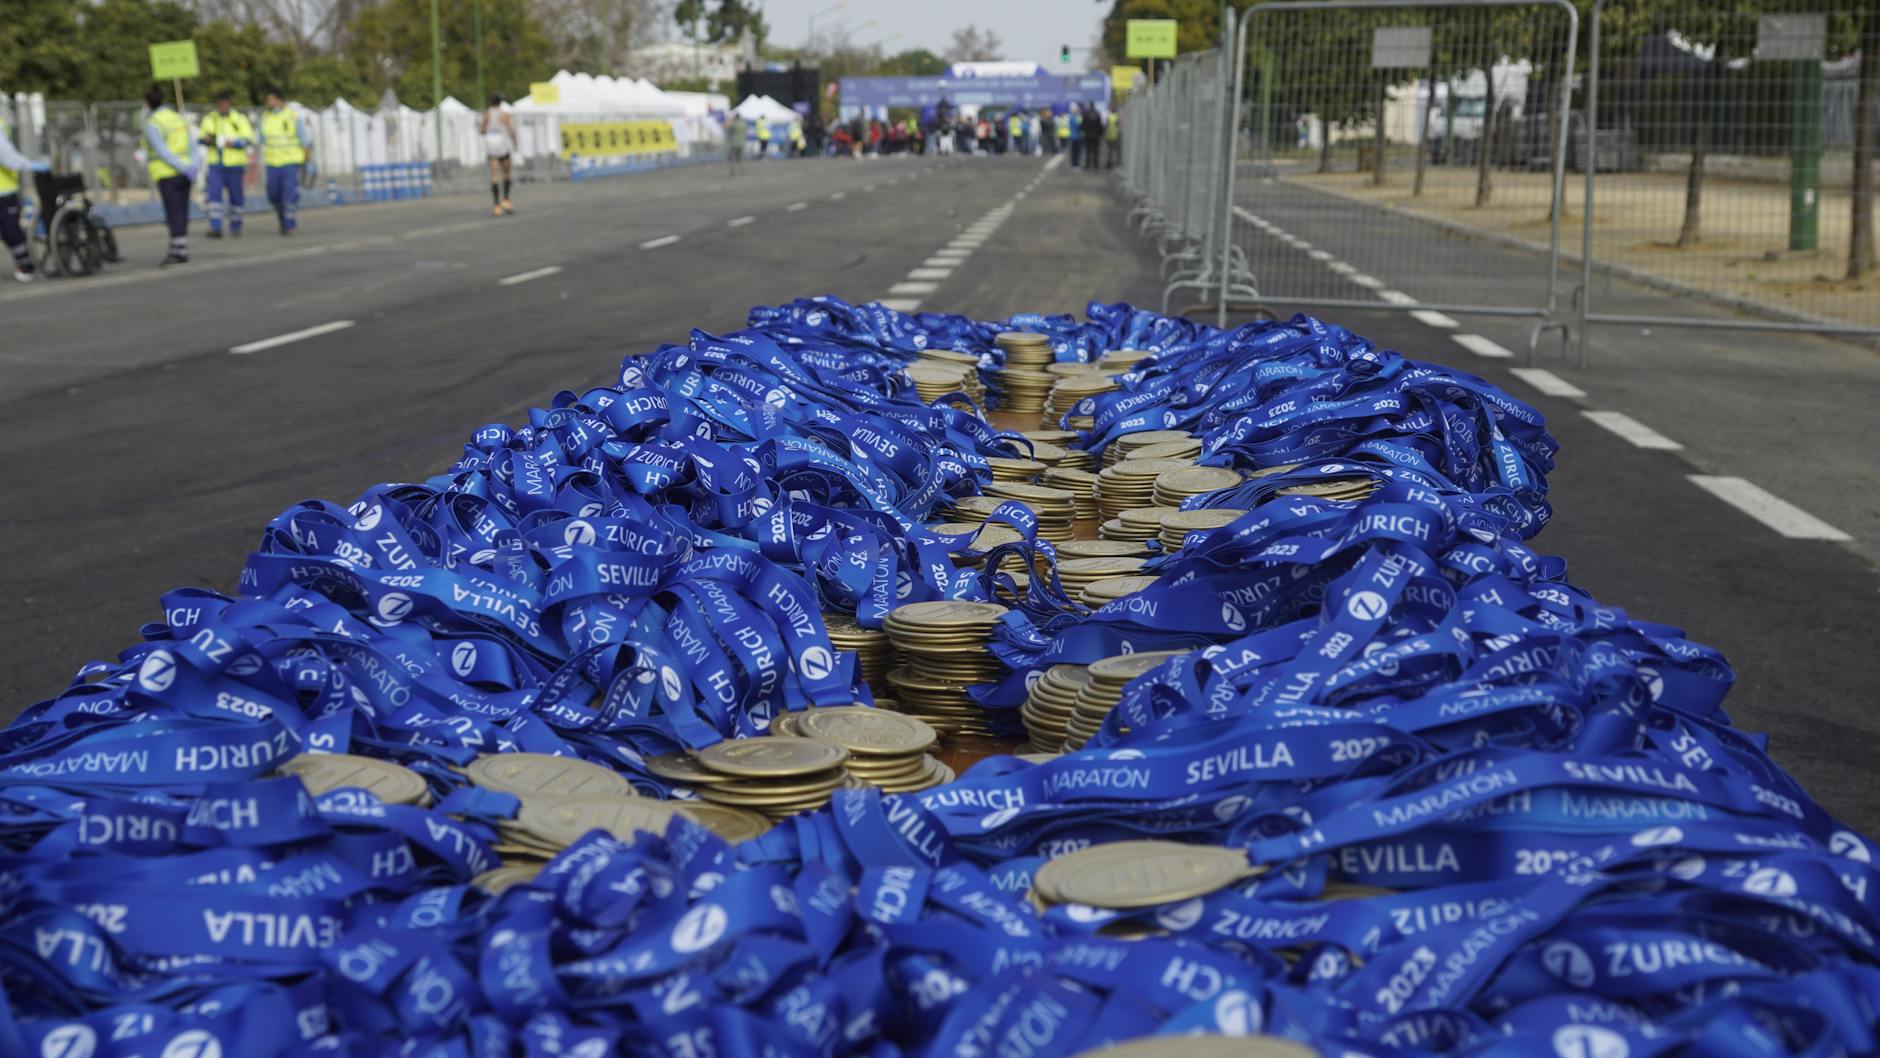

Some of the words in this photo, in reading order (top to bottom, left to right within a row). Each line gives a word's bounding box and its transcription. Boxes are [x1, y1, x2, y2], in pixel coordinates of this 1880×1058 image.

[1268, 401, 1297, 418] 2023
[1372, 399, 1401, 411] 2023
[963, 421, 997, 448] URICH
[1120, 417, 1146, 429] 2023
[851, 426, 898, 458] SEVILLA
[1360, 441, 1419, 466] MARATÓN
[635, 448, 686, 474] ZURICH
[939, 461, 967, 477] 2023
[1501, 446, 1523, 494] ZURICH
[792, 511, 813, 527] 202
[1347, 516, 1430, 542] ZURICH
[334, 540, 374, 569] 2023
[380, 575, 424, 588] 2023
[598, 564, 660, 587] SEVILLA
[452, 584, 541, 638] SEVILLA
[768, 582, 816, 638] ZURICH
[1320, 631, 1354, 659] 2023
[734, 626, 779, 699] ZURICH
[216, 692, 273, 719] 2023
[175, 731, 290, 772] ZURICH
[1186, 742, 1295, 784] SEVILLA
[1563, 761, 1698, 793] SEVILLA
[921, 787, 1025, 811] ZURICH
[1211, 907, 1330, 940] ZURICH
[1376, 946, 1437, 1014] 2023
